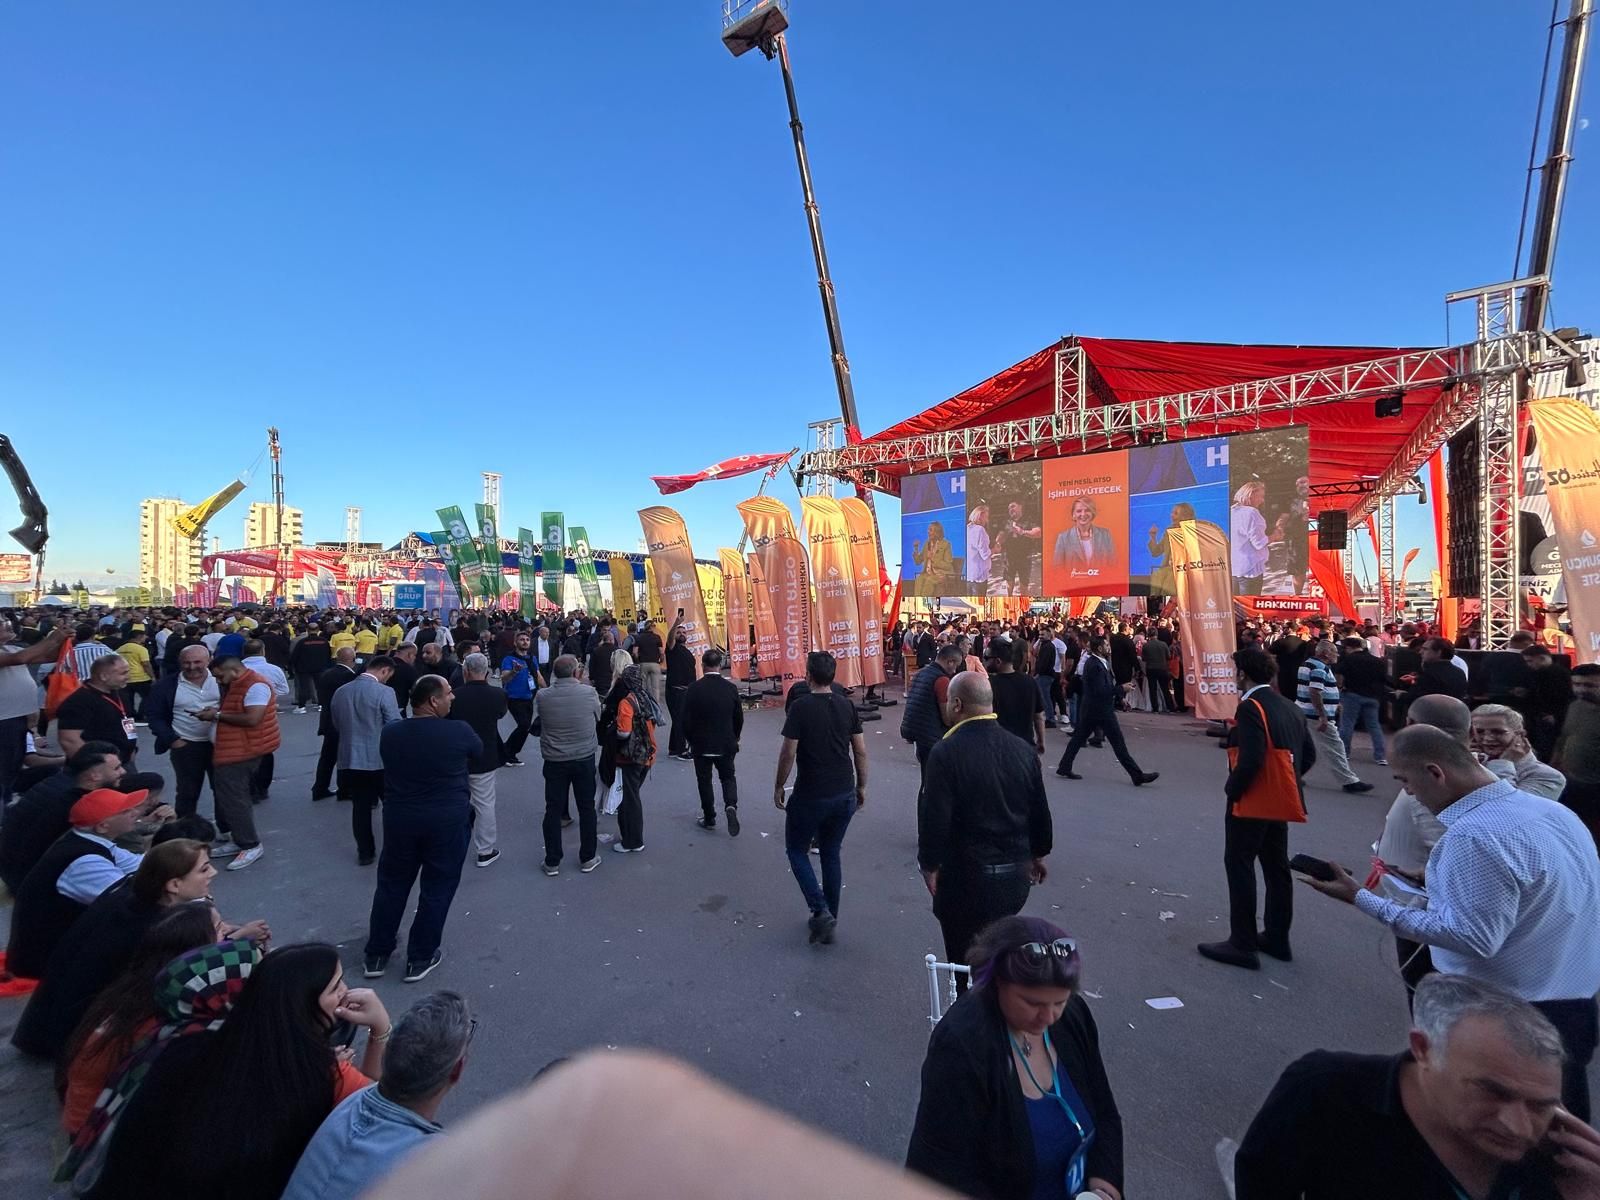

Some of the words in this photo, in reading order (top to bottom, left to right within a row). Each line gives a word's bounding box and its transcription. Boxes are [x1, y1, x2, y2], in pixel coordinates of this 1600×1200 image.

[1048, 488, 1067, 499] İŞİNİ
[1069, 485, 1122, 497] BÜYÜTECEK
[1519, 579, 1548, 587] ENİZ
[1256, 600, 1303, 610] HAKKINI
[1304, 602, 1321, 611] AL
